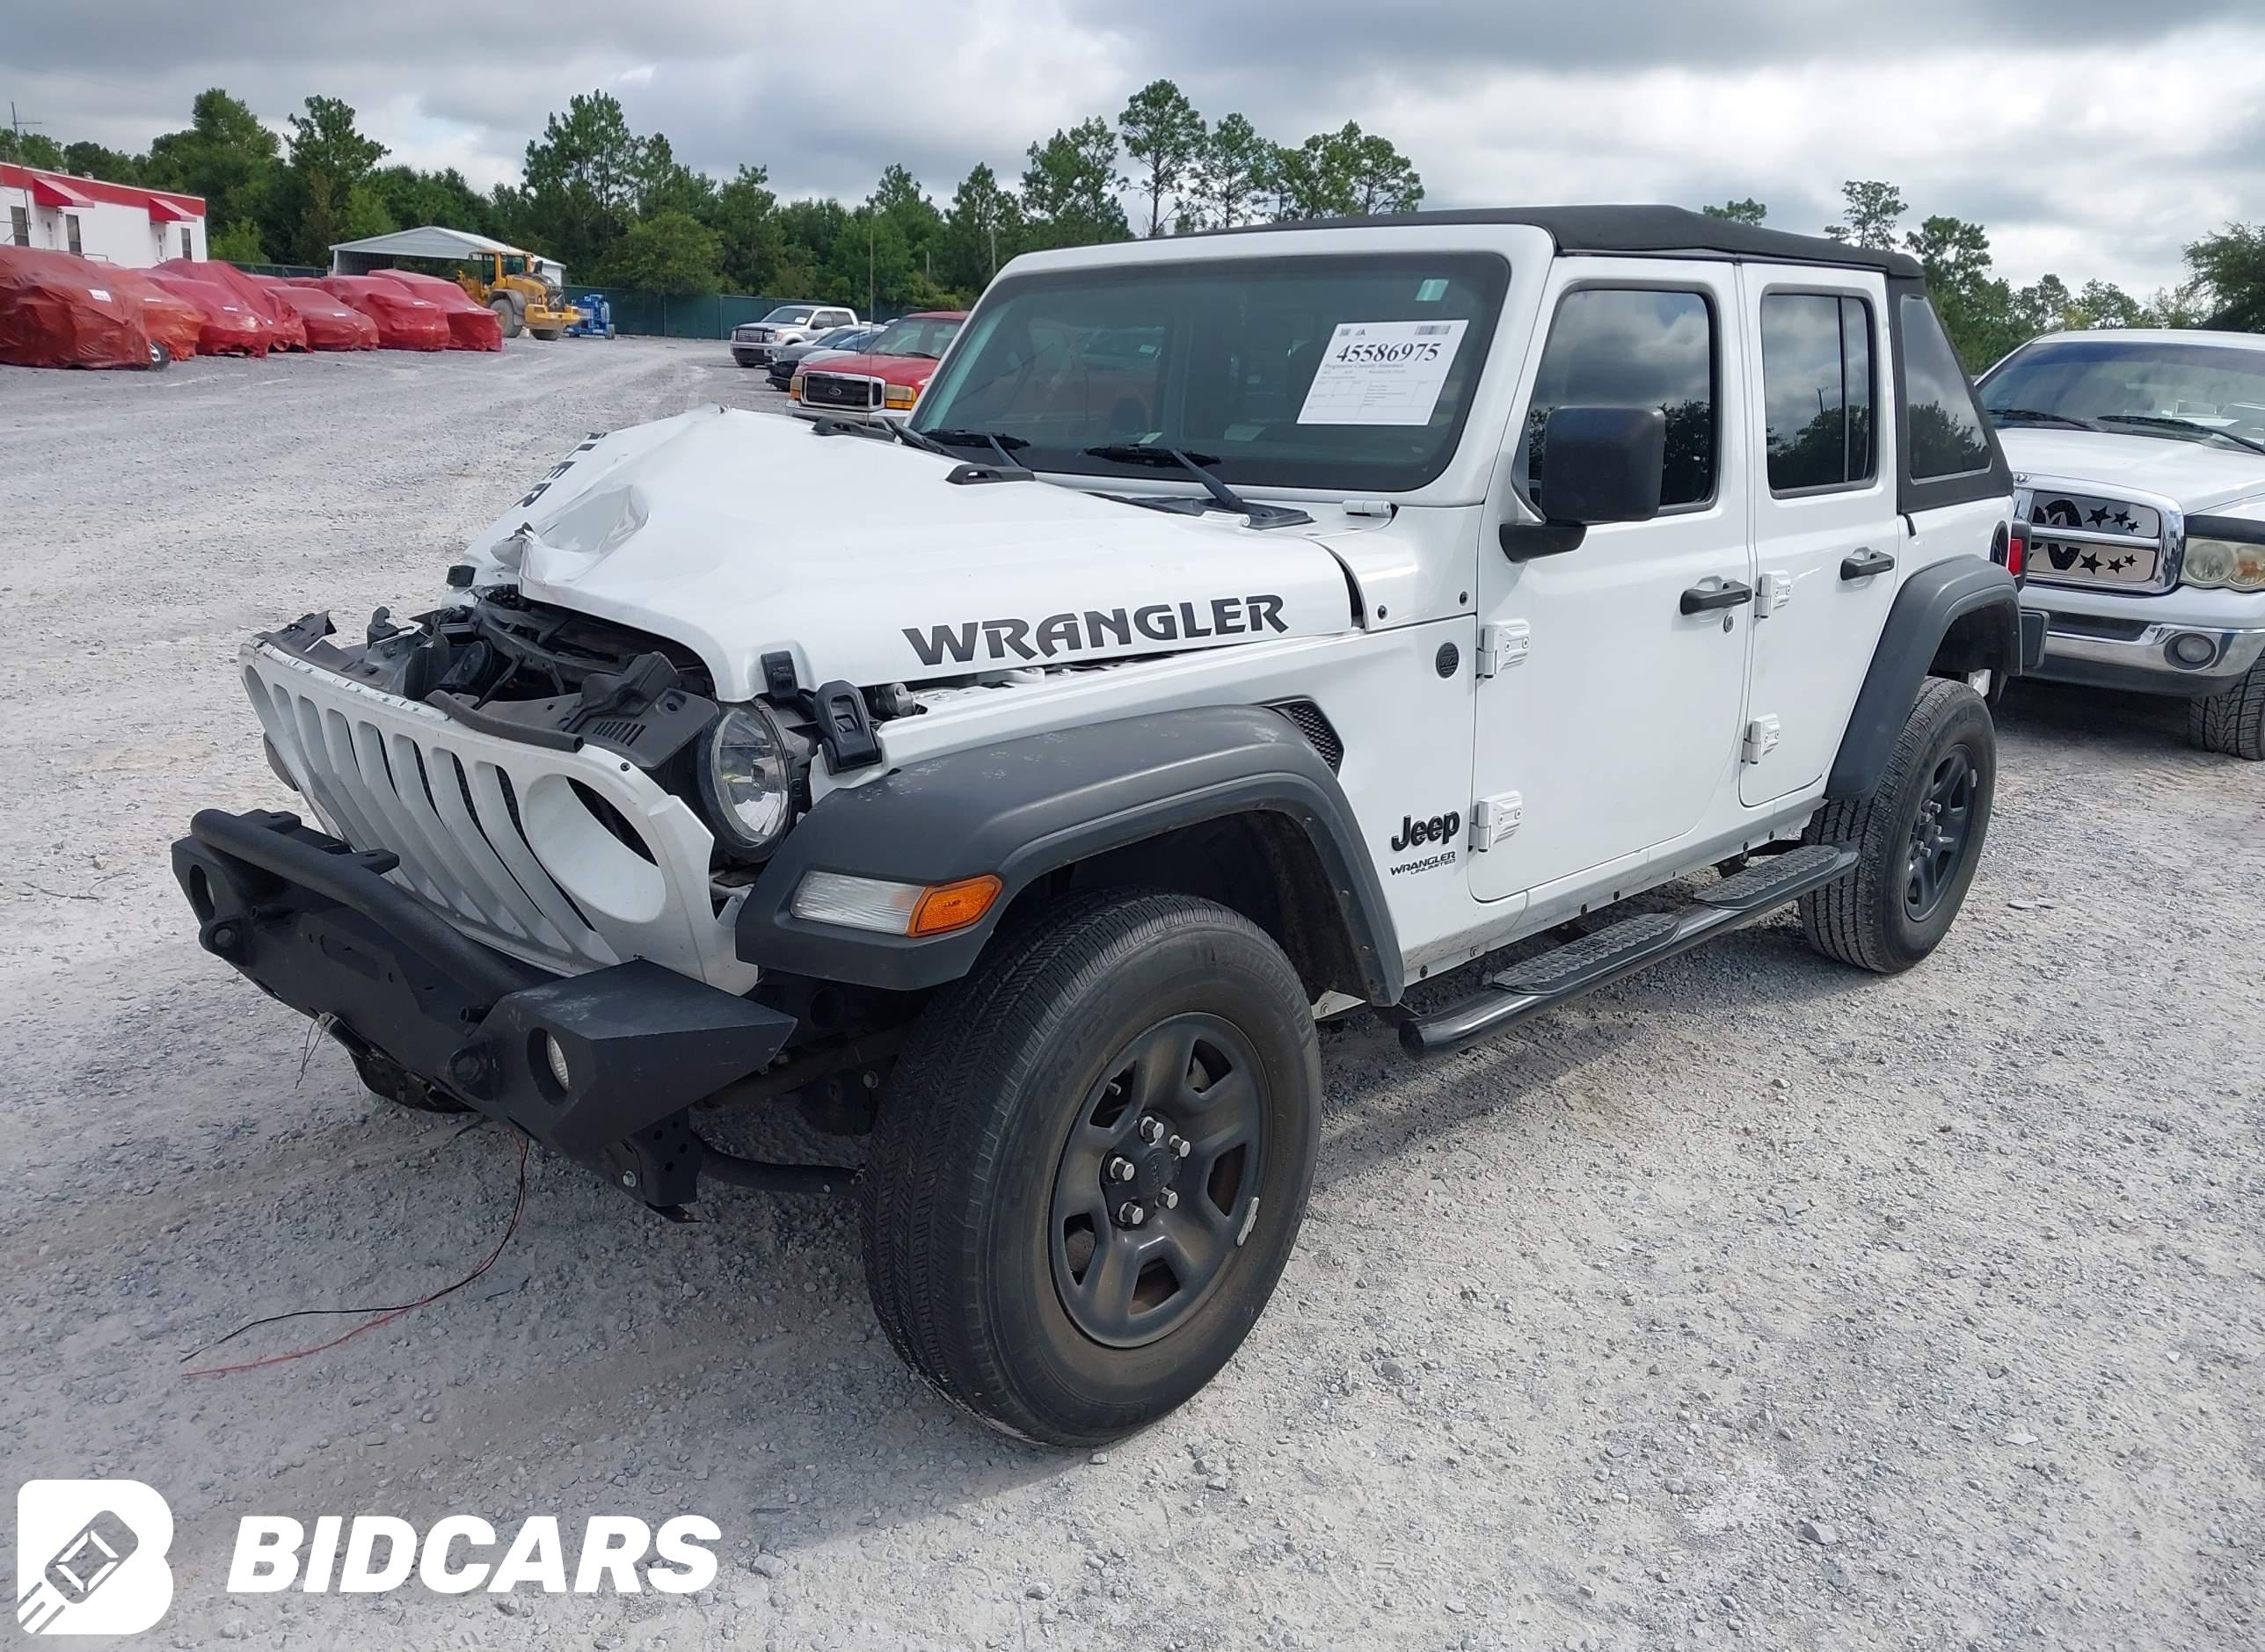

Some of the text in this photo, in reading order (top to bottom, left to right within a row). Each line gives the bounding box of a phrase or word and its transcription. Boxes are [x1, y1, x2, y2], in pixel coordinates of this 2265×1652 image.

[1336, 342, 1442, 362] 45586975
[901, 594, 1289, 666] WRANGLER
[1391, 811, 1460, 852] Jeep
[1390, 851, 1456, 876] WRANGLER
[1410, 858, 1456, 875] UNLIMITED
